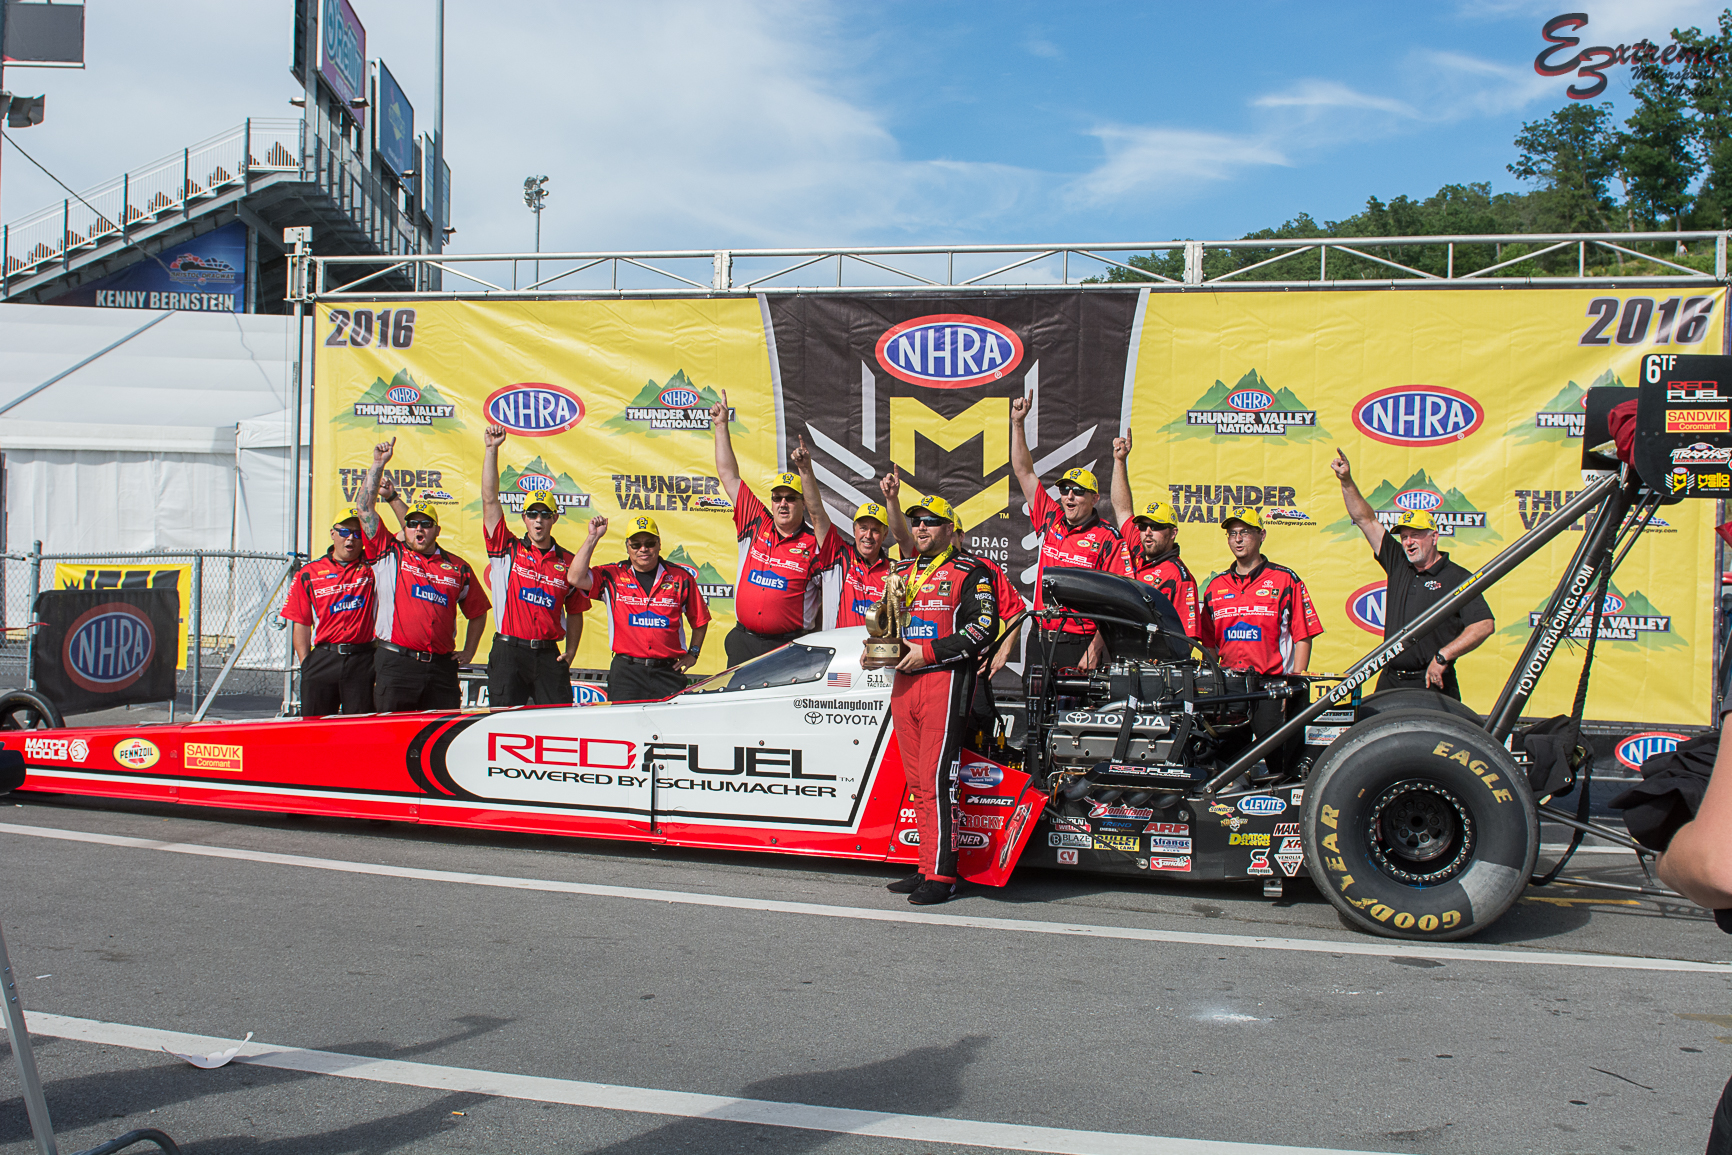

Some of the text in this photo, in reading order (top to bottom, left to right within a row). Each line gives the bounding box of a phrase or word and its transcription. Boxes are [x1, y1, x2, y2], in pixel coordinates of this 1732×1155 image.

[95, 289, 235, 311] KENNY BERNSTEIN
[1578, 296, 1716, 347] 2016
[324, 308, 417, 349] 2016
[898, 327, 1003, 376] NHRA
[1667, 380, 1718, 390] RED
[389, 387, 419, 402] NHRA
[664, 390, 697, 406] NHRA
[1232, 391, 1269, 408] NHRA
[1666, 389, 1728, 400] FUEL
[355, 404, 453, 417] THUNDER VALLEY
[498, 391, 571, 428] NHRA
[628, 408, 733, 421] THUNDER VALY
[1371, 395, 1467, 437] NHRA
[1667, 411, 1727, 421] SANDVIK
[379, 415, 431, 425] NATIONALS
[651, 419, 709, 429] NATIONALS
[1188, 412, 1313, 425] THUNDER VALLEY
[1217, 424, 1285, 434] NATIONALS
[338, 468, 443, 488] THNDER
[611, 474, 721, 495] THUNDER
[555, 494, 589, 506] ALLEY
[616, 493, 693, 511] VALLEY
[1168, 484, 1297, 507] THUNDER
[1400, 491, 1438, 510] NHRA
[1172, 505, 1264, 523] VALL
[971, 536, 1009, 548] DRAG
[750, 571, 785, 589] LOWE'S
[701, 585, 733, 597] ALLEY
[1237, 605, 1275, 614] FUEL
[632, 615, 667, 627] LOWE'S
[1608, 617, 1669, 631] VALLEY
[1227, 628, 1259, 640] LOWE'S
[1515, 563, 1595, 697] TOYOTARACING.COM
[78, 618, 144, 677] NHRA
[866, 674, 884, 683] 5.11
[1329, 642, 1405, 704] GOODYEAR
[793, 698, 884, 712] @ShawnLangdonTF
[825, 713, 878, 726] TOYOTA
[25, 737, 69, 750] MATCO
[26, 749, 68, 760] TOOLS
[119, 746, 154, 760] PENNZOIL
[186, 745, 241, 758] SANDVIK
[487, 731, 638, 770] RED
[641, 741, 837, 781] FUEL
[196, 757, 231, 768] Coromant
[1108, 764, 1147, 773] RED
[1432, 740, 1513, 804] EAGLE
[487, 766, 837, 798] POWERED BY SCHUMACHER
[978, 798, 1014, 806] IMPACT
[1241, 797, 1283, 810] CLEVITE
[966, 815, 1005, 830] ROCKY
[1101, 820, 1132, 828] TREND
[1143, 822, 1189, 834] ARP
[1062, 834, 1091, 843] BLAZE
[1060, 850, 1076, 861] CV
[1321, 804, 1462, 931] GOODYEAR
